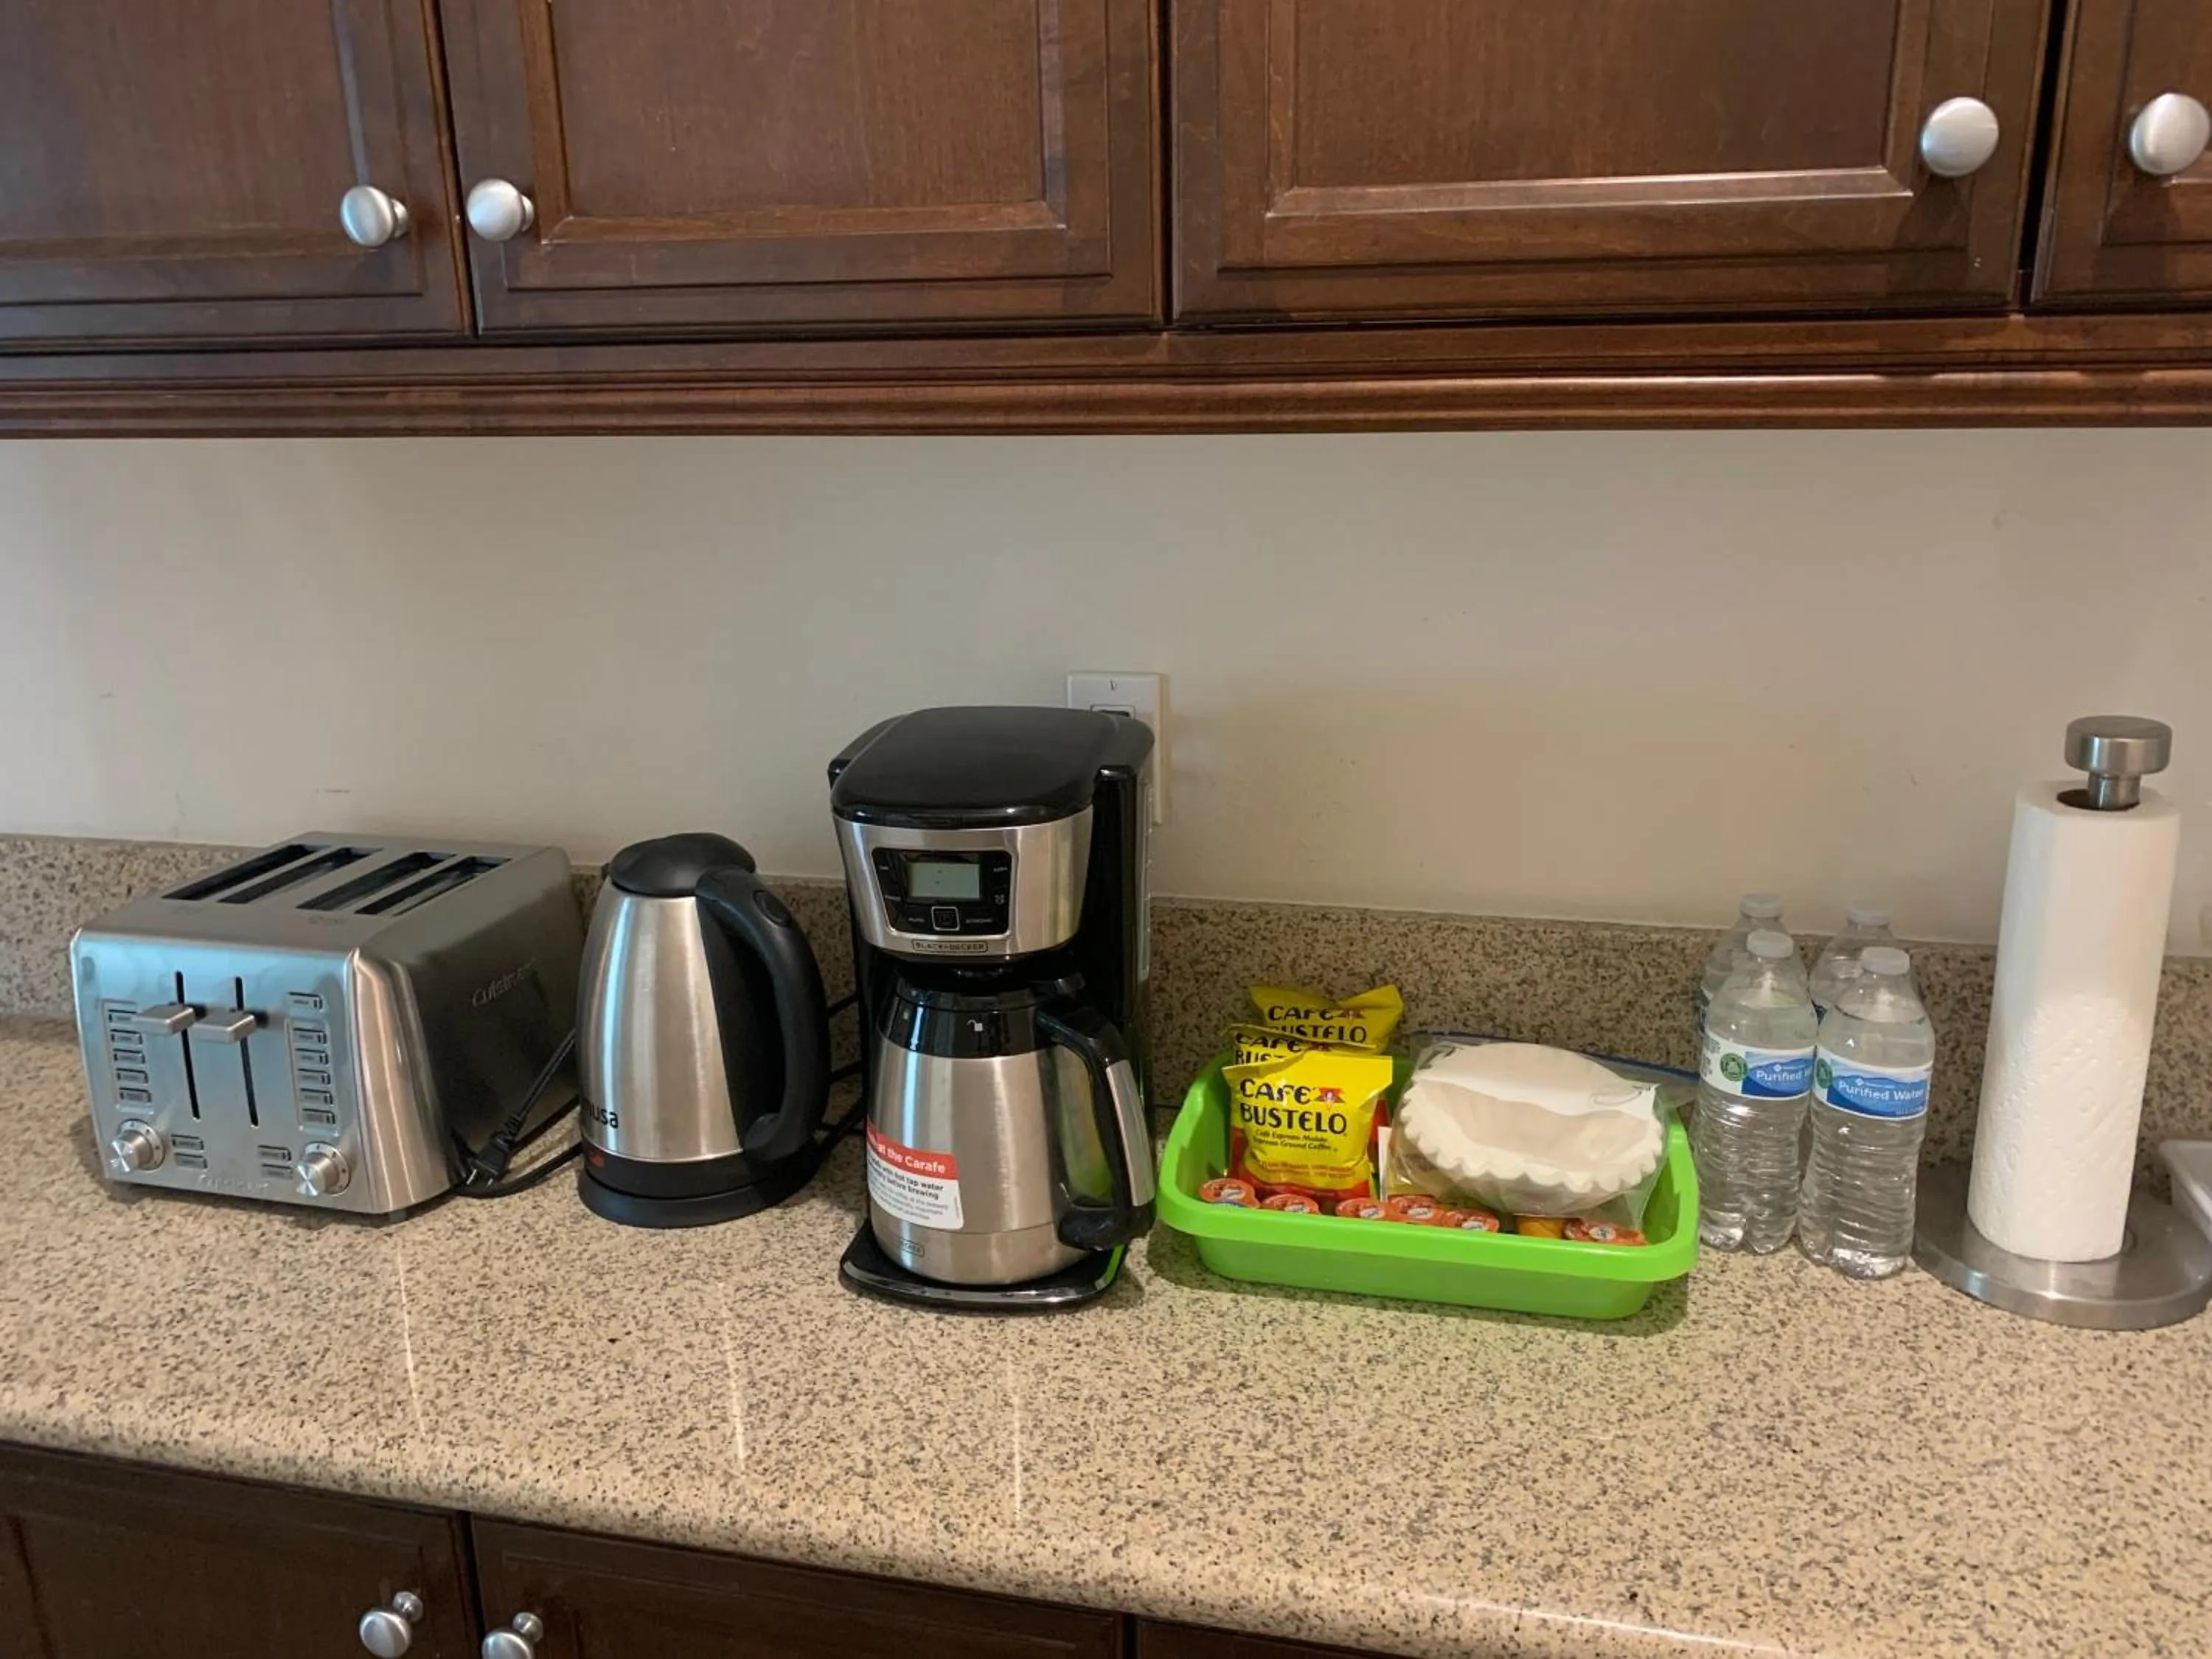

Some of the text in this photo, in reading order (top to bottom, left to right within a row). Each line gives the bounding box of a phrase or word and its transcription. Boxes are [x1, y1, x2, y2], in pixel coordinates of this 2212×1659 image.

[1756, 1070, 1803, 1082] Purified
[1838, 1079, 1890, 1101] Purified
[1892, 1089, 1924, 1101] Water
[1239, 1102, 1347, 1134] BUSTELO
[905, 1155, 946, 1174] Carafe
[908, 1185, 939, 1200] brewing
[920, 1182, 944, 1191] water
